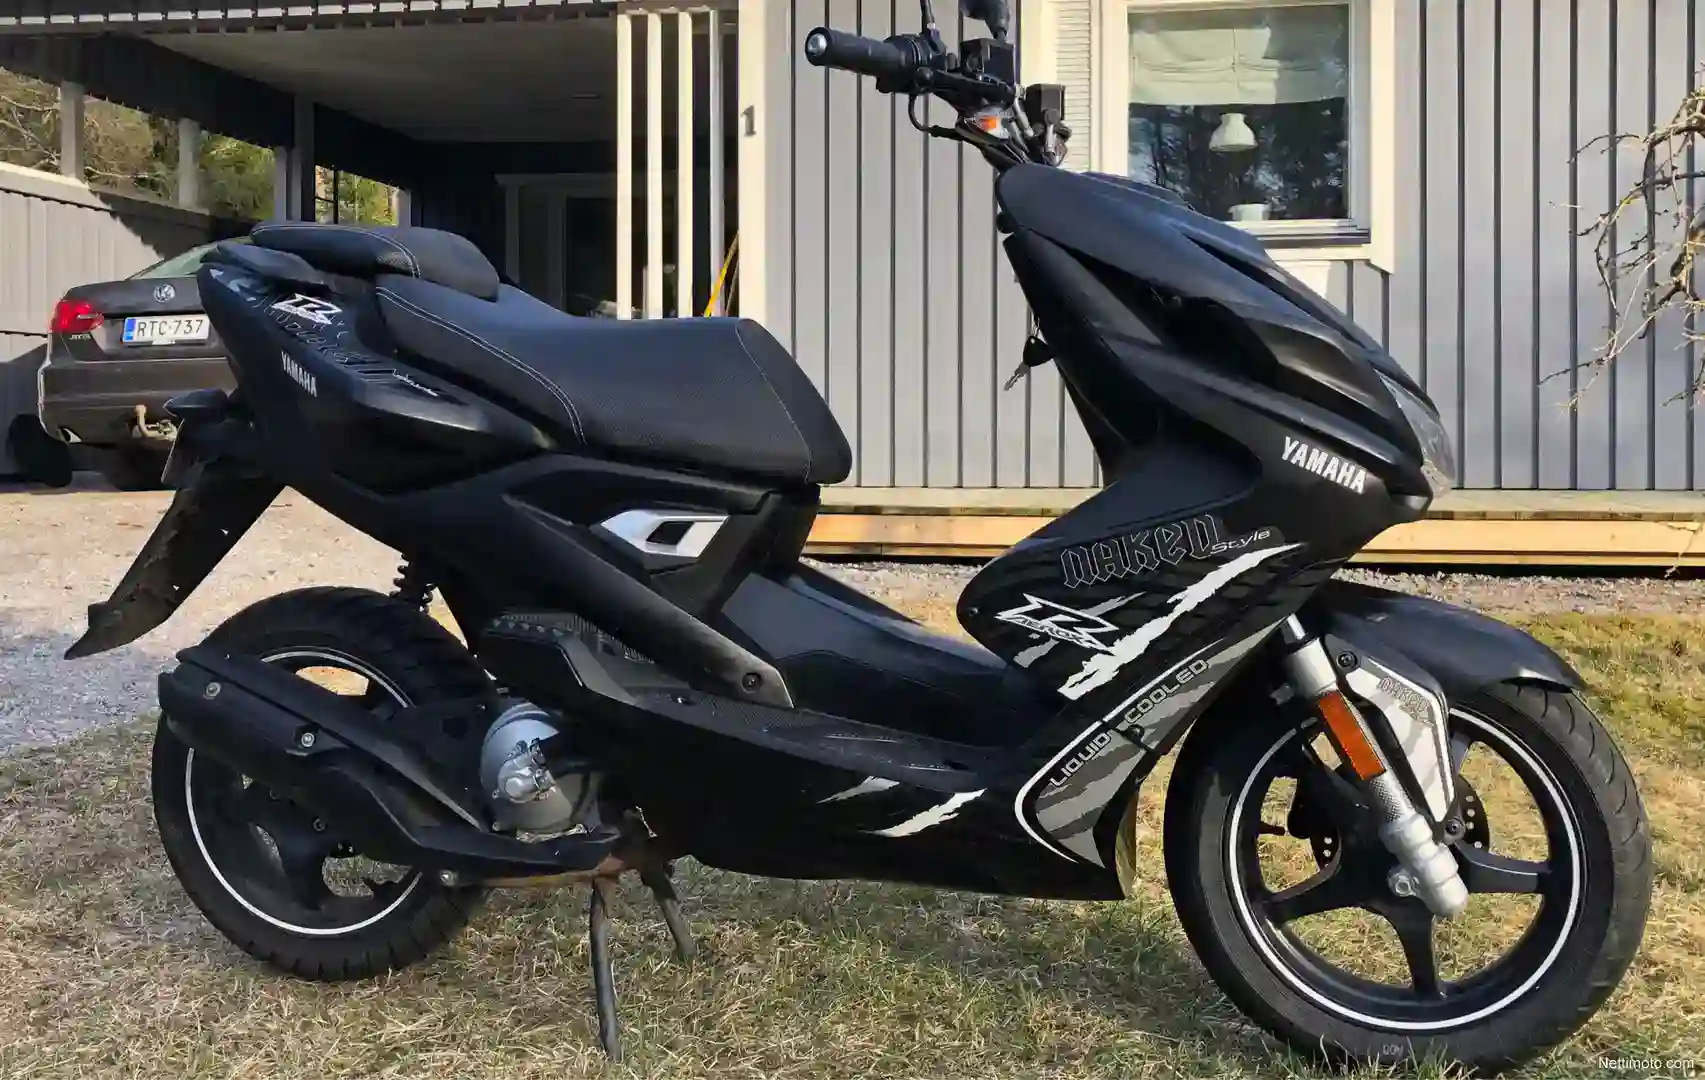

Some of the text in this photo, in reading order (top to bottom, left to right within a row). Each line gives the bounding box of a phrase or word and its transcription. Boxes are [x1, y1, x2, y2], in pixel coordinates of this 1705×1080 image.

[742, 104, 757, 137] 1
[136, 319, 204, 337] RTC-737
[280, 351, 318, 398] YAMAHA
[1281, 436, 1367, 494] YAMAHA
[1210, 528, 1270, 555] Style
[1004, 614, 1086, 645] AEROX
[1049, 658, 1210, 786] LIQUID COOLED
